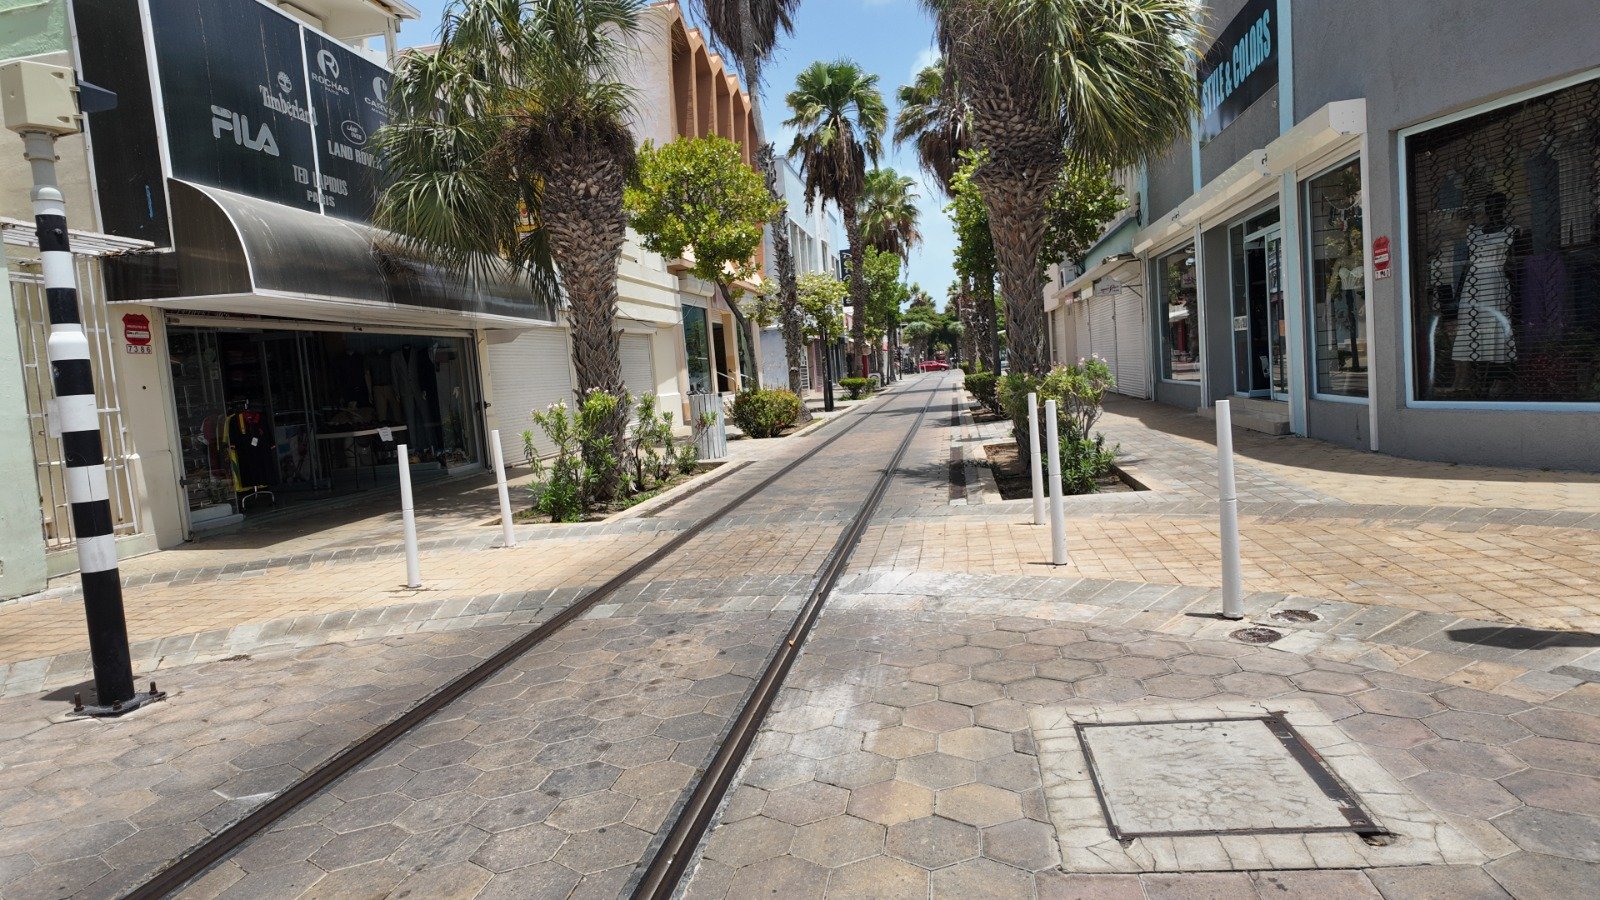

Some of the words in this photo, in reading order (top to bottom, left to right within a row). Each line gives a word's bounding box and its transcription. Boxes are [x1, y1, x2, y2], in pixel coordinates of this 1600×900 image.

[1202, 61, 1225, 120] STYLE
[1225, 61, 1233, 98] &
[1232, 8, 1271, 89] COLORS
[311, 72, 350, 95] ROCHAS
[259, 84, 319, 127] Timberland
[210, 104, 280, 157] FILA
[327, 139, 354, 161] LAND
[292, 164, 309, 185] TED
[312, 171, 349, 196] LAPIDUS
[128, 345, 151, 353] 7386
